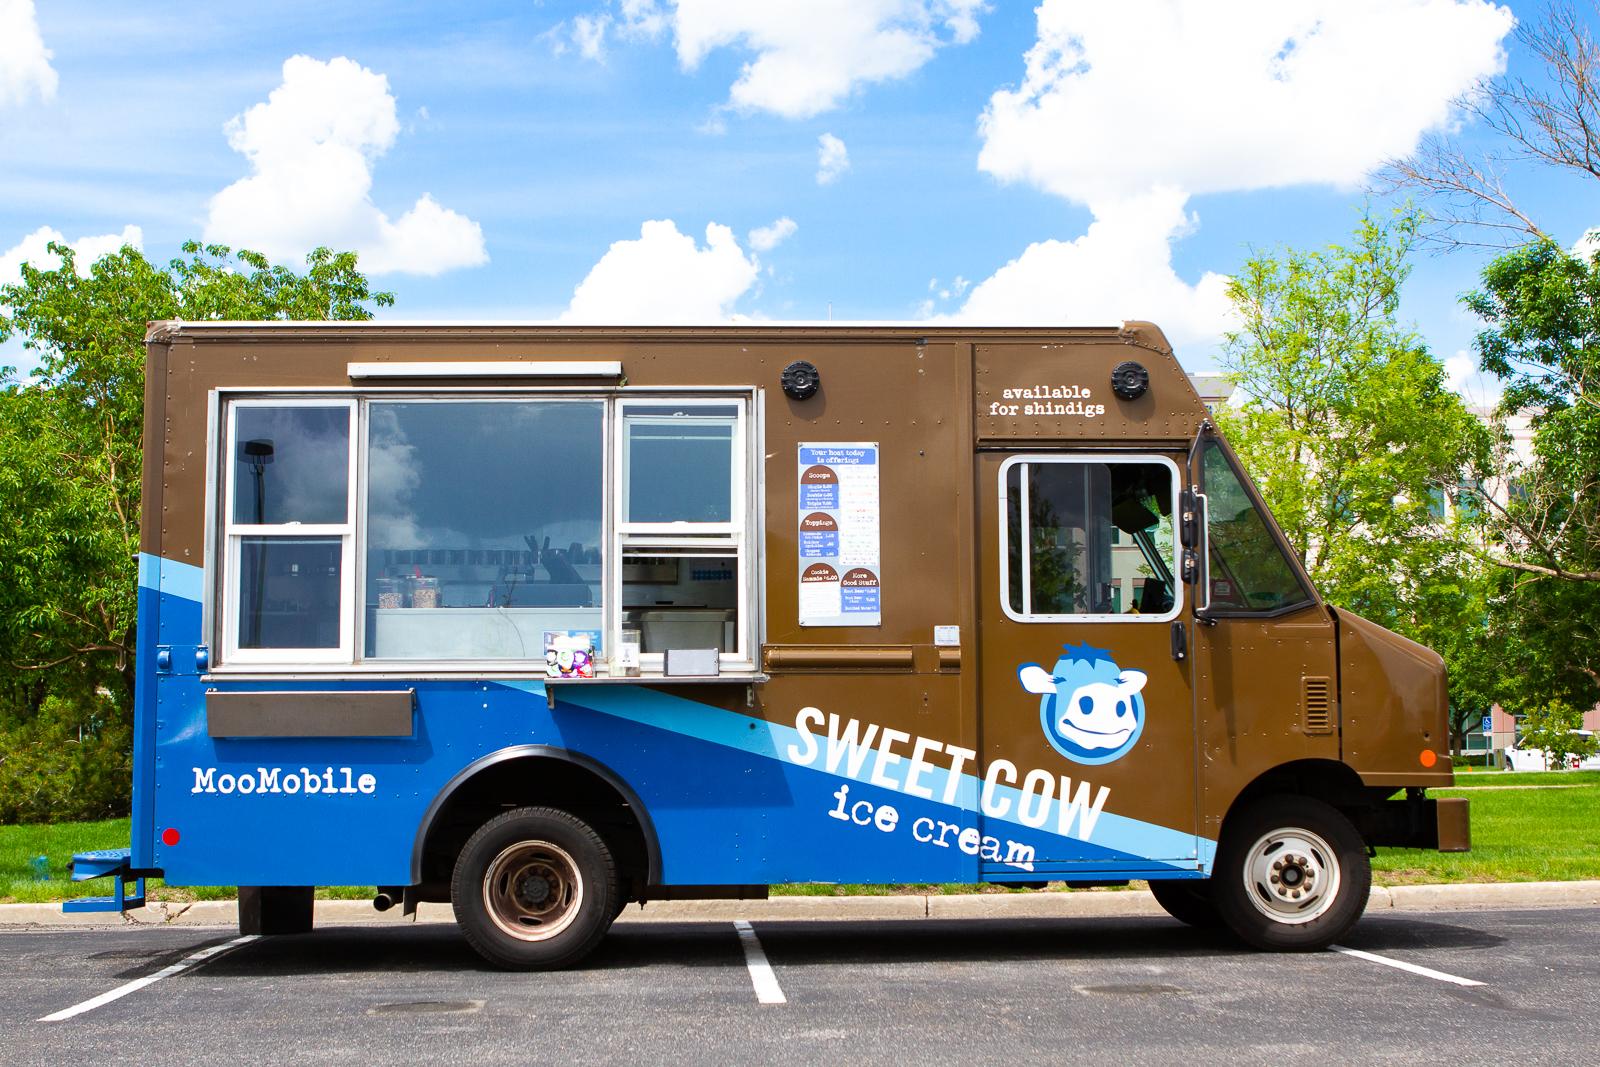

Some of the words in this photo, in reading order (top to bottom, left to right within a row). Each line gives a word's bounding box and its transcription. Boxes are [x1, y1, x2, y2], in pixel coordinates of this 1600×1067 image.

[1002, 385, 1092, 399] available
[989, 402, 1019, 416] for
[1024, 402, 1105, 417] shindigs
[846, 449, 866, 457] today
[804, 519, 833, 527] Toppings
[191, 767, 377, 794] MooMobile
[787, 706, 977, 805] SWEET
[980, 759, 1111, 842] COW
[828, 784, 899, 832] ice
[912, 816, 1036, 871] cream
